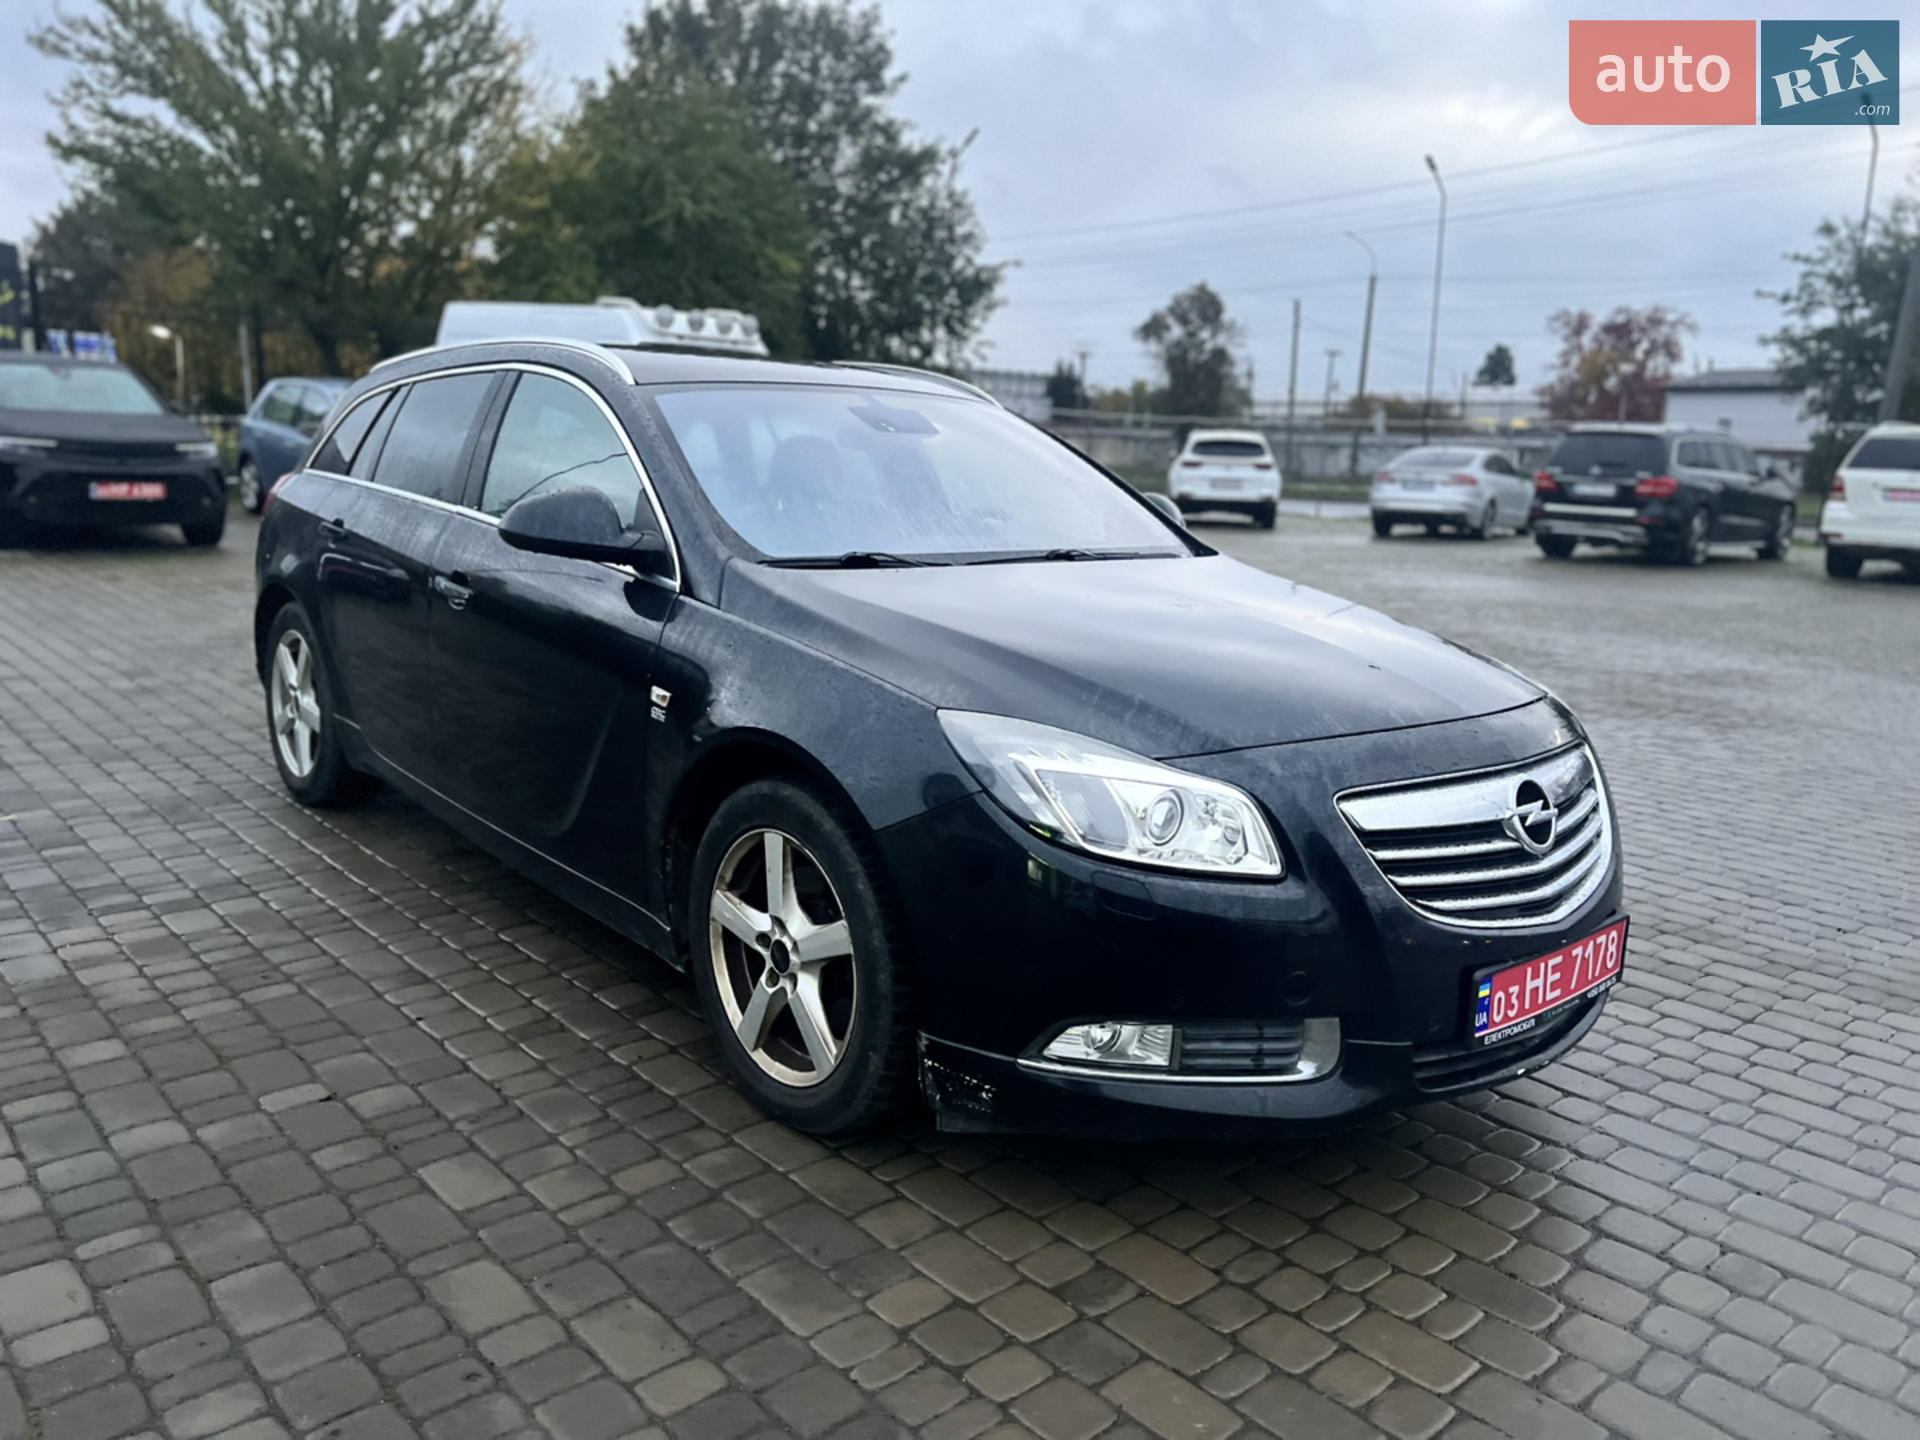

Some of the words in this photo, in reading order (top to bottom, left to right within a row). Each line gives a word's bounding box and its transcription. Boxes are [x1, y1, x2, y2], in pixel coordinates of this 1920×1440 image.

[1492, 984, 1520, 1023] 03
[1524, 955, 1563, 1010] HE
[1570, 930, 1618, 990] 7178
[1475, 1011, 1488, 1027] UA
